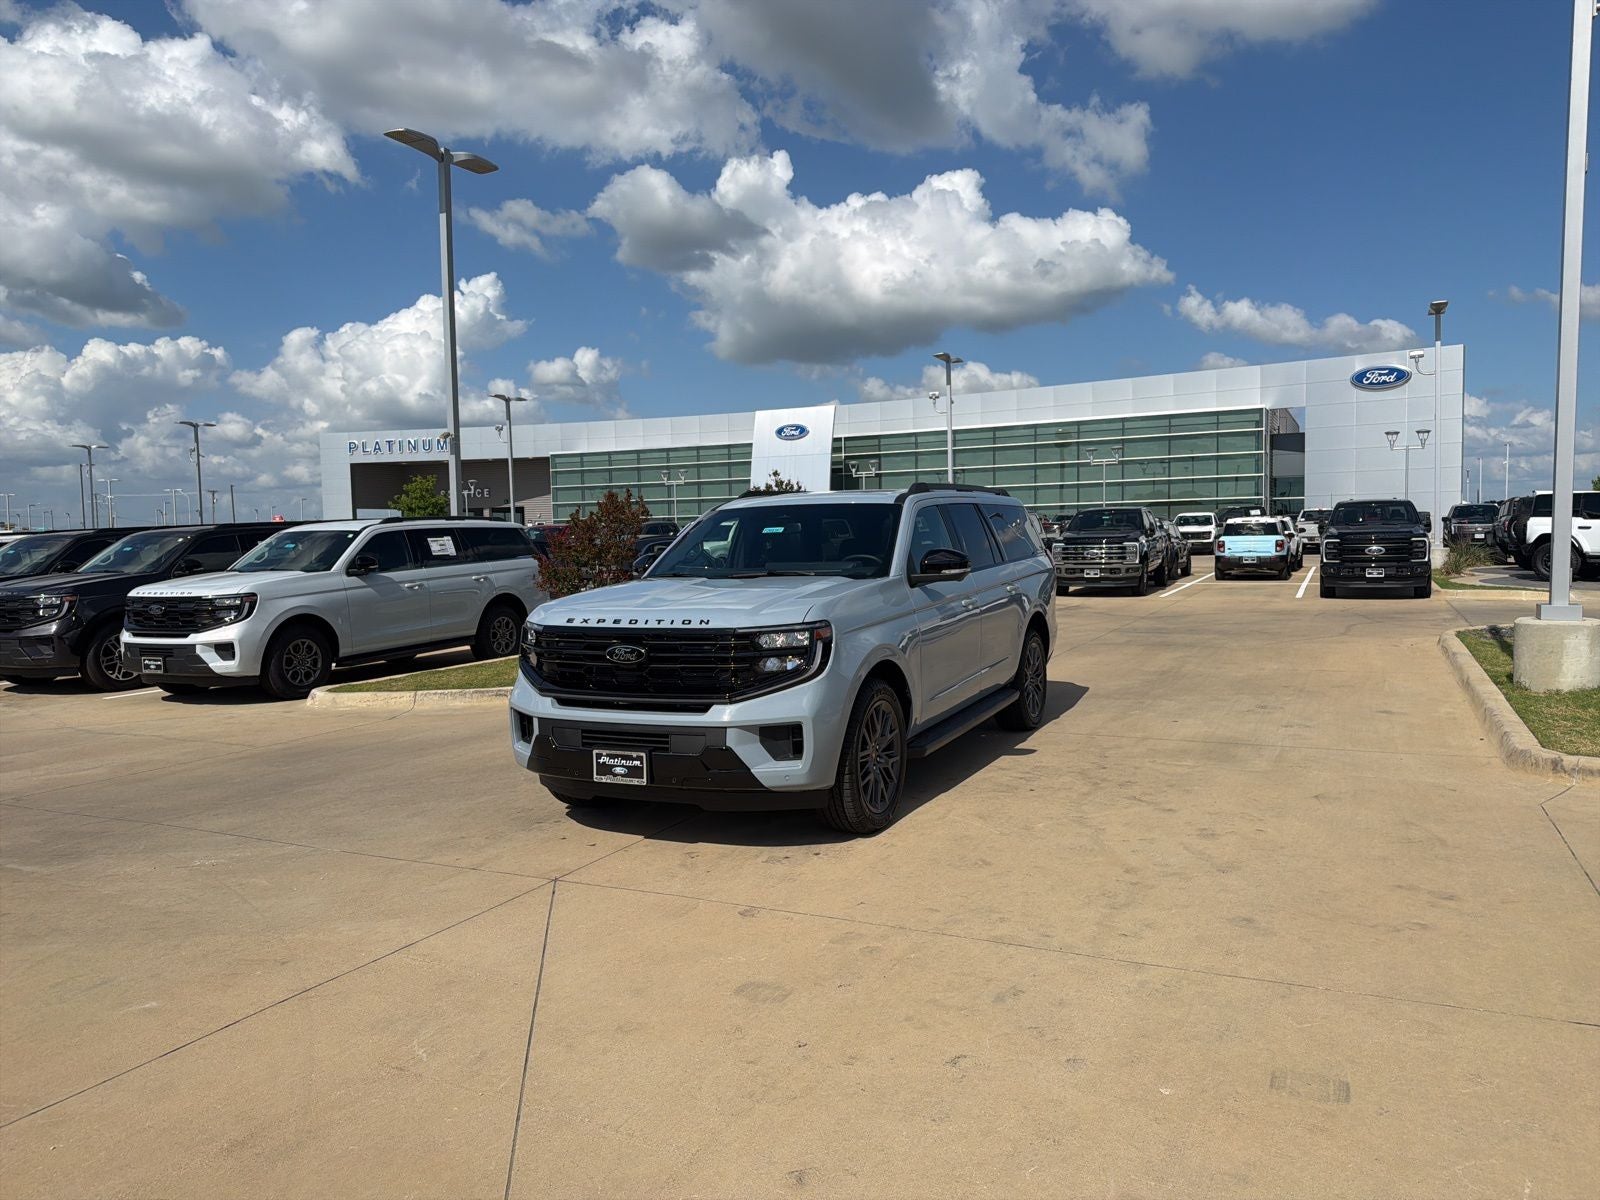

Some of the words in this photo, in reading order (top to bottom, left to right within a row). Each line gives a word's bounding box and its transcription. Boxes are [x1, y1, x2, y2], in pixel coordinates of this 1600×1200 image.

[1362, 369, 1398, 384] Ford
[781, 426, 801, 437] Ford
[348, 438, 449, 454] PLATINUM
[565, 617, 711, 626] EXPEDITION
[612, 647, 637, 661] Ford
[597, 756, 643, 767] Platinum
